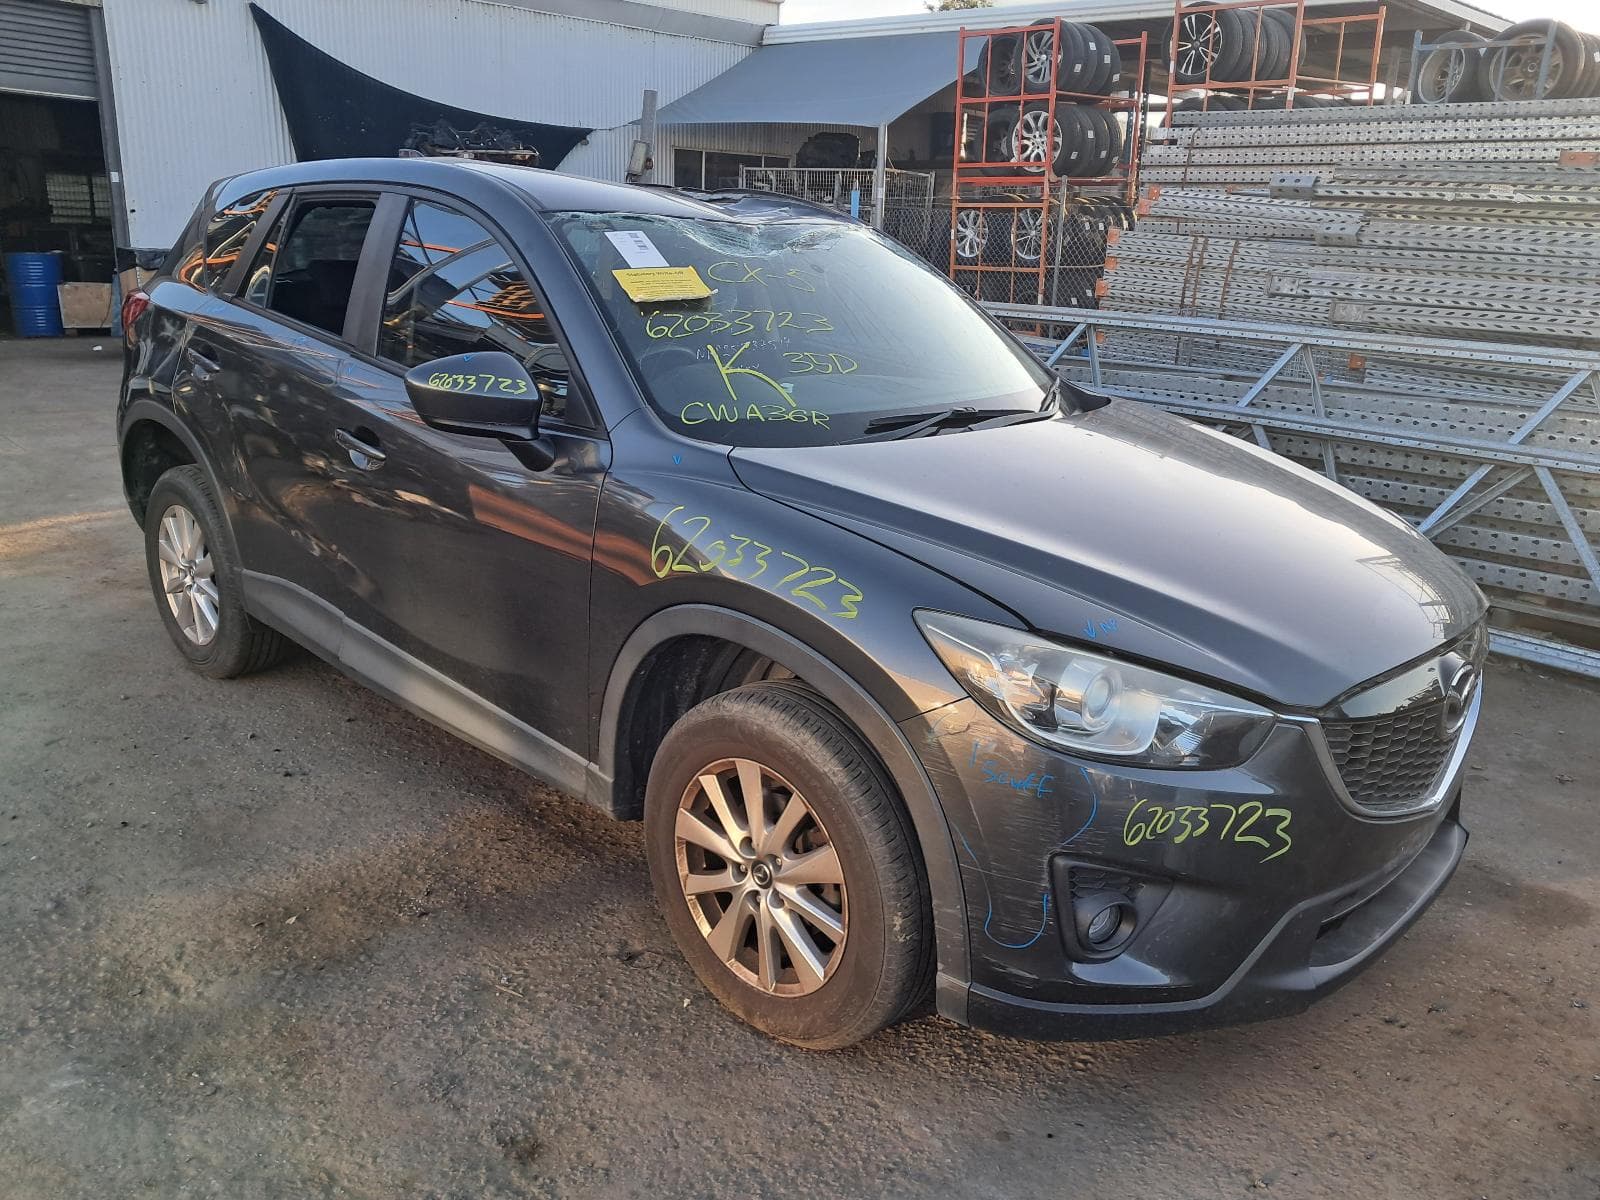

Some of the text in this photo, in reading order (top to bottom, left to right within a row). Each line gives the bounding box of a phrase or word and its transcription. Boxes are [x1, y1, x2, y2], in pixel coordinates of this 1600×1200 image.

[428, 372, 527, 394] 62033723
[651, 506, 864, 619] 62033723
[1123, 799, 1293, 863] 62033723
